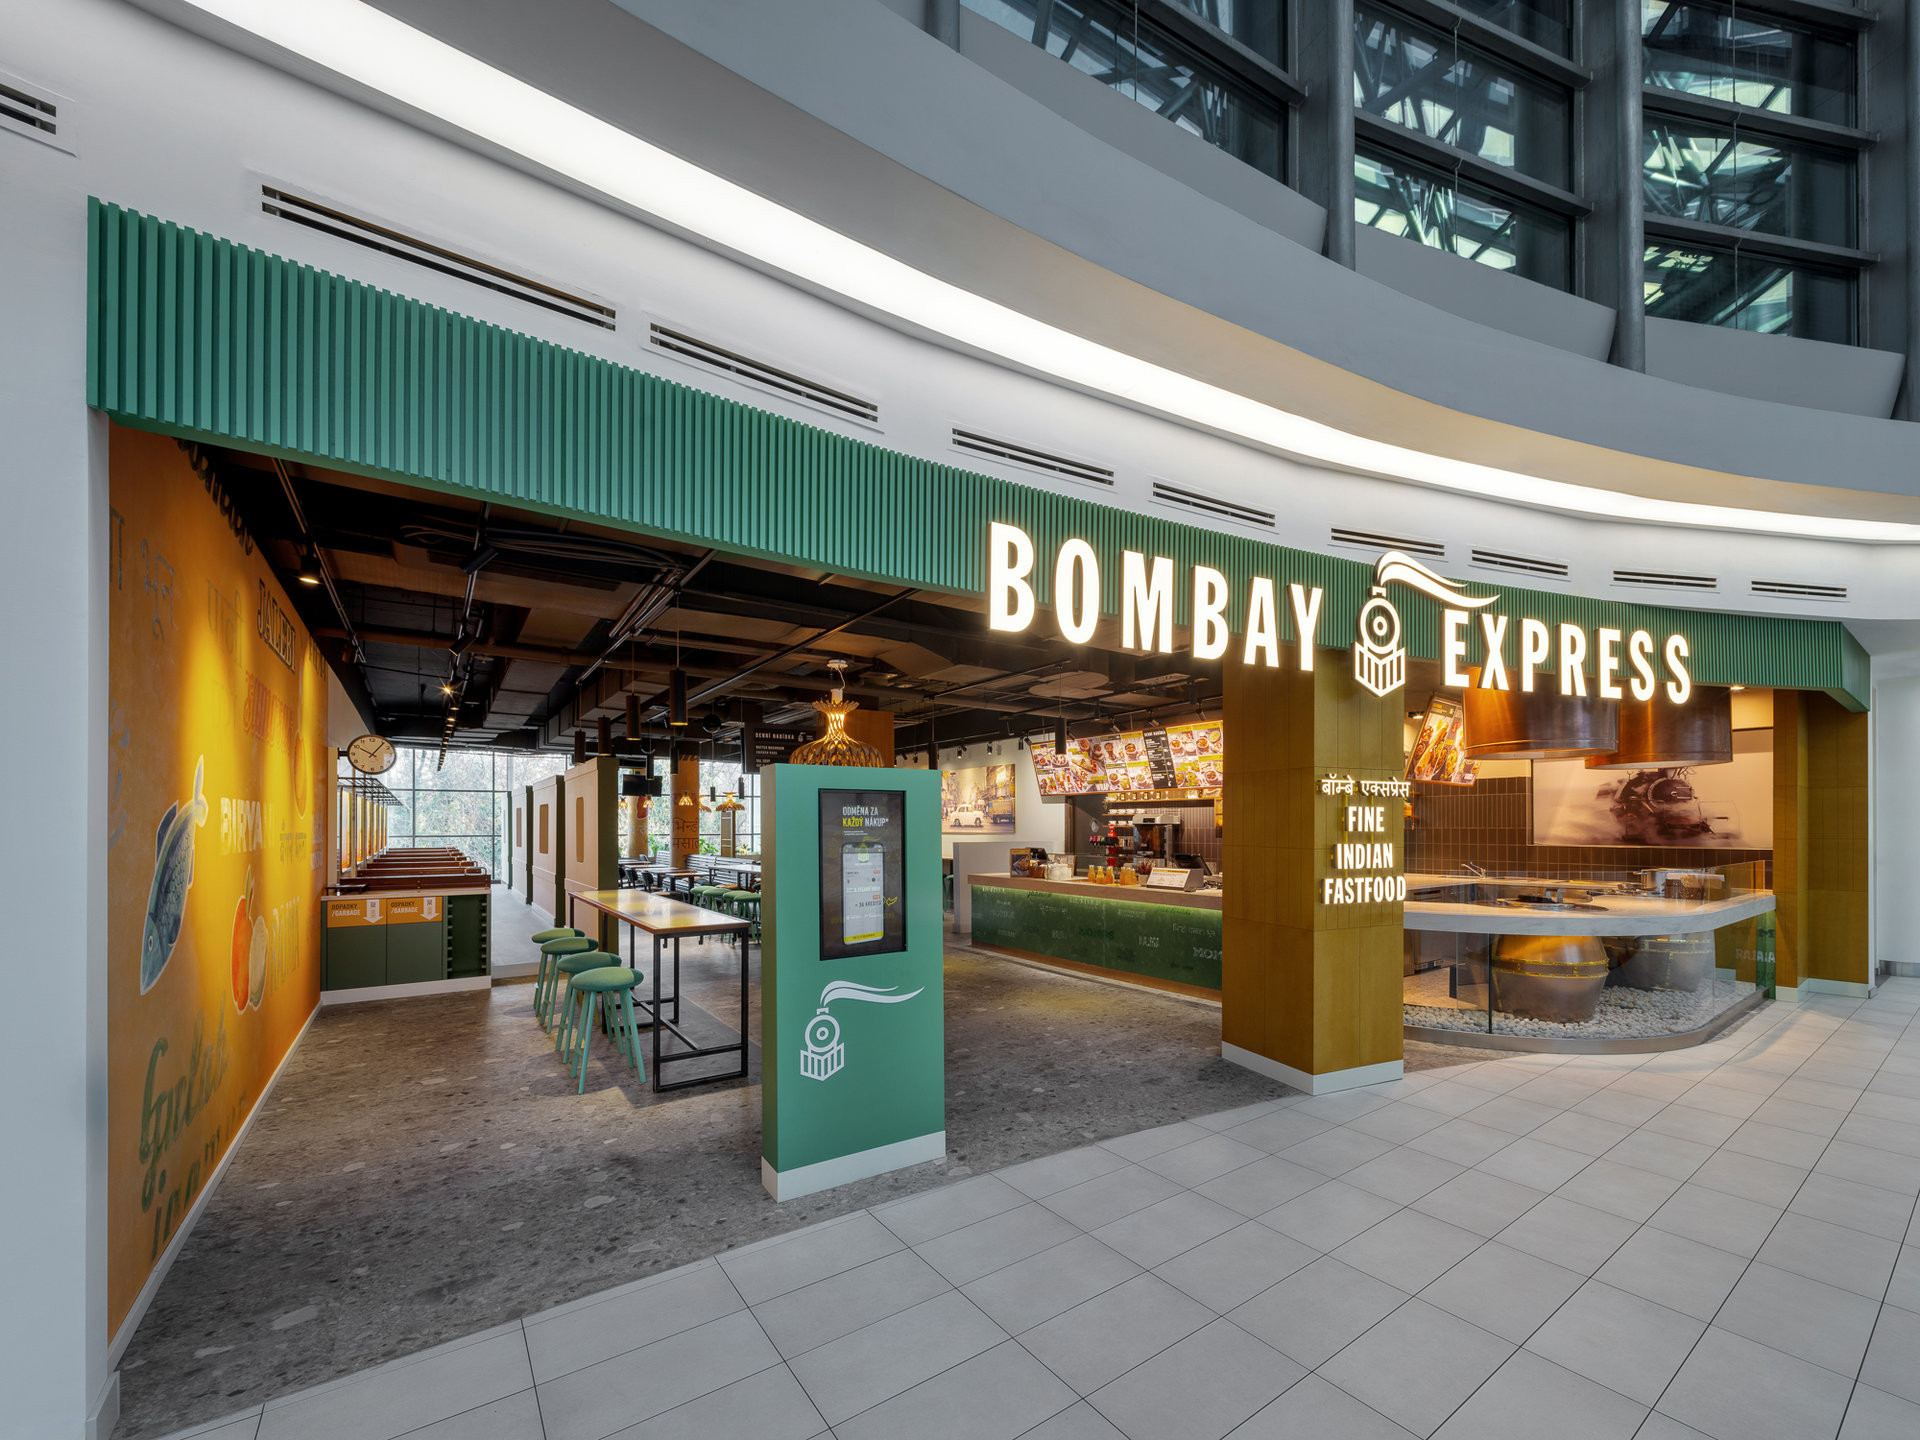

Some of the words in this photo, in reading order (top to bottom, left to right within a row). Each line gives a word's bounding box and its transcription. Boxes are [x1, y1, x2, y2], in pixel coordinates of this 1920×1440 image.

[988, 521, 1323, 671] BOMBAY
[1443, 608, 1692, 704] EXPRESS
[257, 578, 295, 675] JALEBI
[1321, 773, 1356, 796] बॉम्बे
[1360, 776, 1411, 797] एक्सप्रेस
[842, 805, 869, 816] ODMĚNA
[870, 806, 879, 816] ZA
[842, 816, 864, 827] KAŽDÝ
[1347, 806, 1385, 832] FINE
[1336, 843, 1393, 869] INDIAN
[1324, 875, 1407, 904] FASTFOOD
